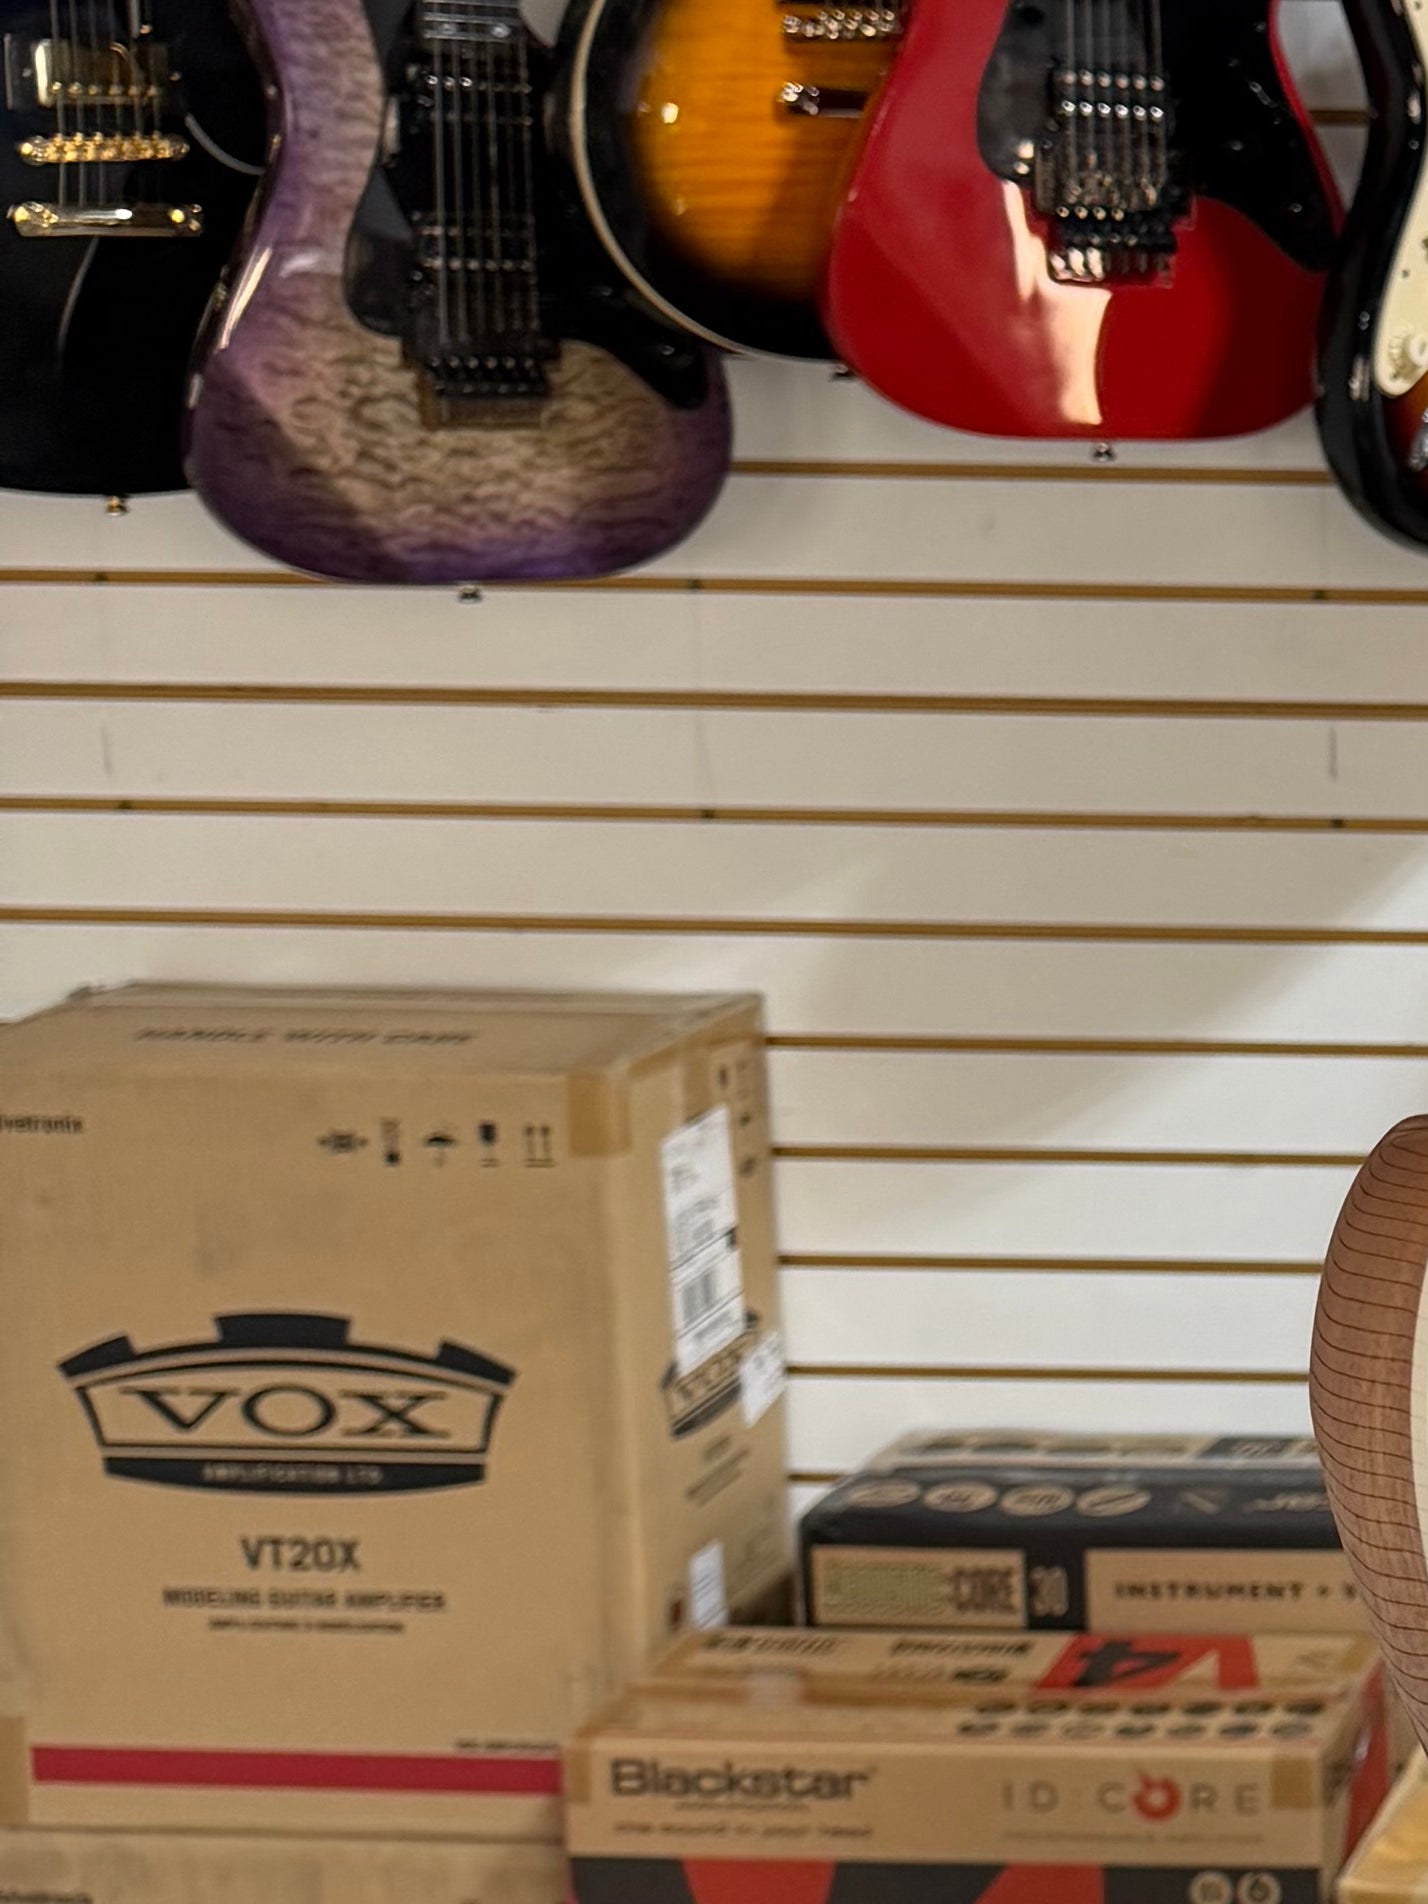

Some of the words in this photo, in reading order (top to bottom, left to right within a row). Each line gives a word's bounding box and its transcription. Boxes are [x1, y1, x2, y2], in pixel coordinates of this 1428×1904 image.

[119, 1382, 452, 1438] VOX
[240, 1536, 361, 1572] VT20X
[610, 1757, 870, 1799] Blackstar
